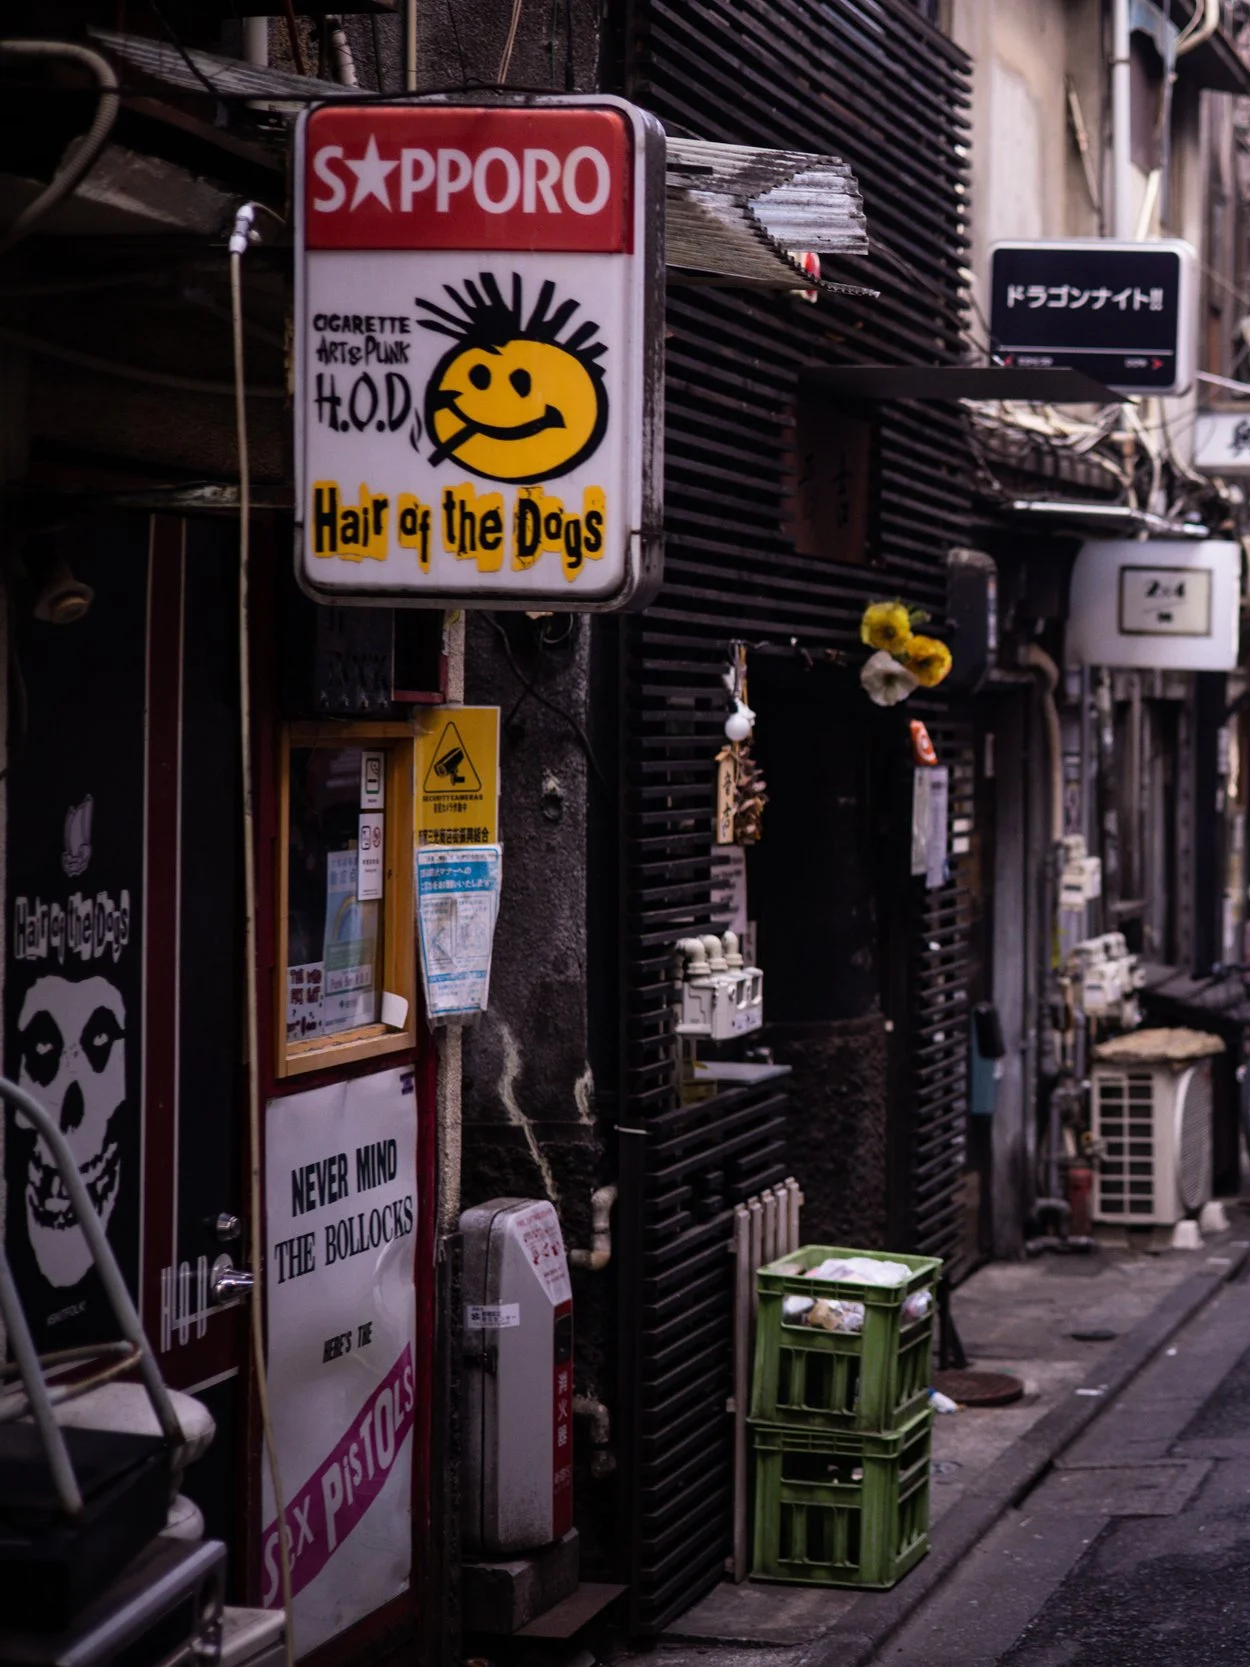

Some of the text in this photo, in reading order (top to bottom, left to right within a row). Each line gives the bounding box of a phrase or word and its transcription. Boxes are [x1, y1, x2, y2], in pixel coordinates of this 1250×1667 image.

[313, 313, 412, 334] CIGARETTE
[313, 487, 605, 569] Hair of the Dogs
[14, 896, 48, 960] Hair
[292, 1138, 397, 1217] NEVER MIND
[275, 1195, 414, 1284] THE BOLLOCKS
[322, 1321, 373, 1373] HERE'S THE
[557, 1371, 568, 1448] 消火器
